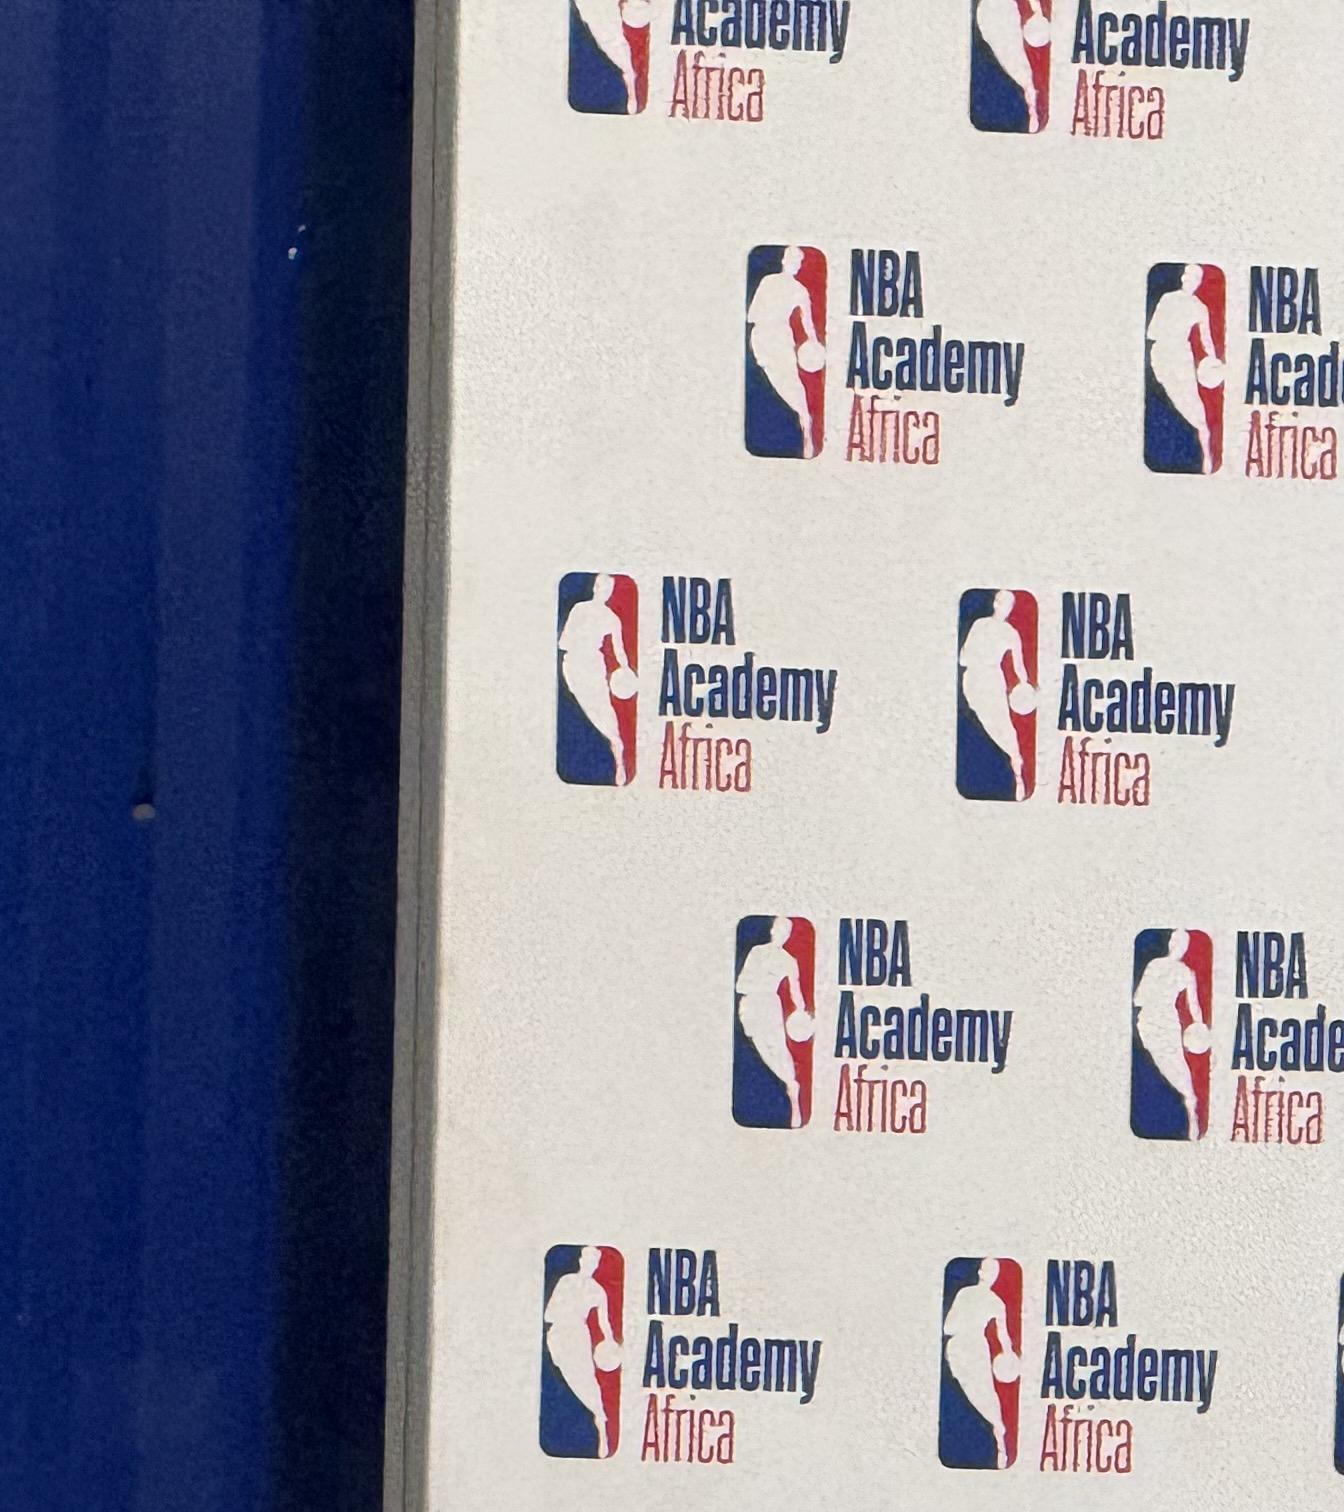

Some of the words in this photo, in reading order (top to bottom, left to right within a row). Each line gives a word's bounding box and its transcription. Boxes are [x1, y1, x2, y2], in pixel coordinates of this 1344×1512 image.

[1070, 0, 1249, 81] Academy
[670, 50, 766, 123] Africa
[1070, 70, 1166, 141] Africa
[848, 249, 923, 318] NBA
[1247, 265, 1321, 335] NBA
[845, 320, 1024, 406] Academy
[1244, 337, 1344, 407] Acad
[846, 395, 942, 465] Africa
[1244, 411, 1339, 481] Africa
[659, 575, 735, 645] NBA
[1060, 591, 1133, 661] NBA
[657, 648, 836, 733] Academy
[1056, 663, 1234, 747] Academy
[656, 723, 754, 794] Africa
[1057, 736, 1153, 806] Africa
[837, 917, 912, 987] NBA
[1234, 931, 1309, 998] NBA
[833, 990, 1011, 1073] Academy
[832, 1064, 929, 1134] Africa
[1230, 1076, 1324, 1145] Africa
[645, 1247, 719, 1317] NBA
[1044, 1259, 1119, 1328] NBA
[641, 1320, 821, 1404] Academy
[1039, 1331, 1217, 1413] Academy
[639, 1393, 737, 1465] Africa
[1038, 1405, 1135, 1474] Africa
